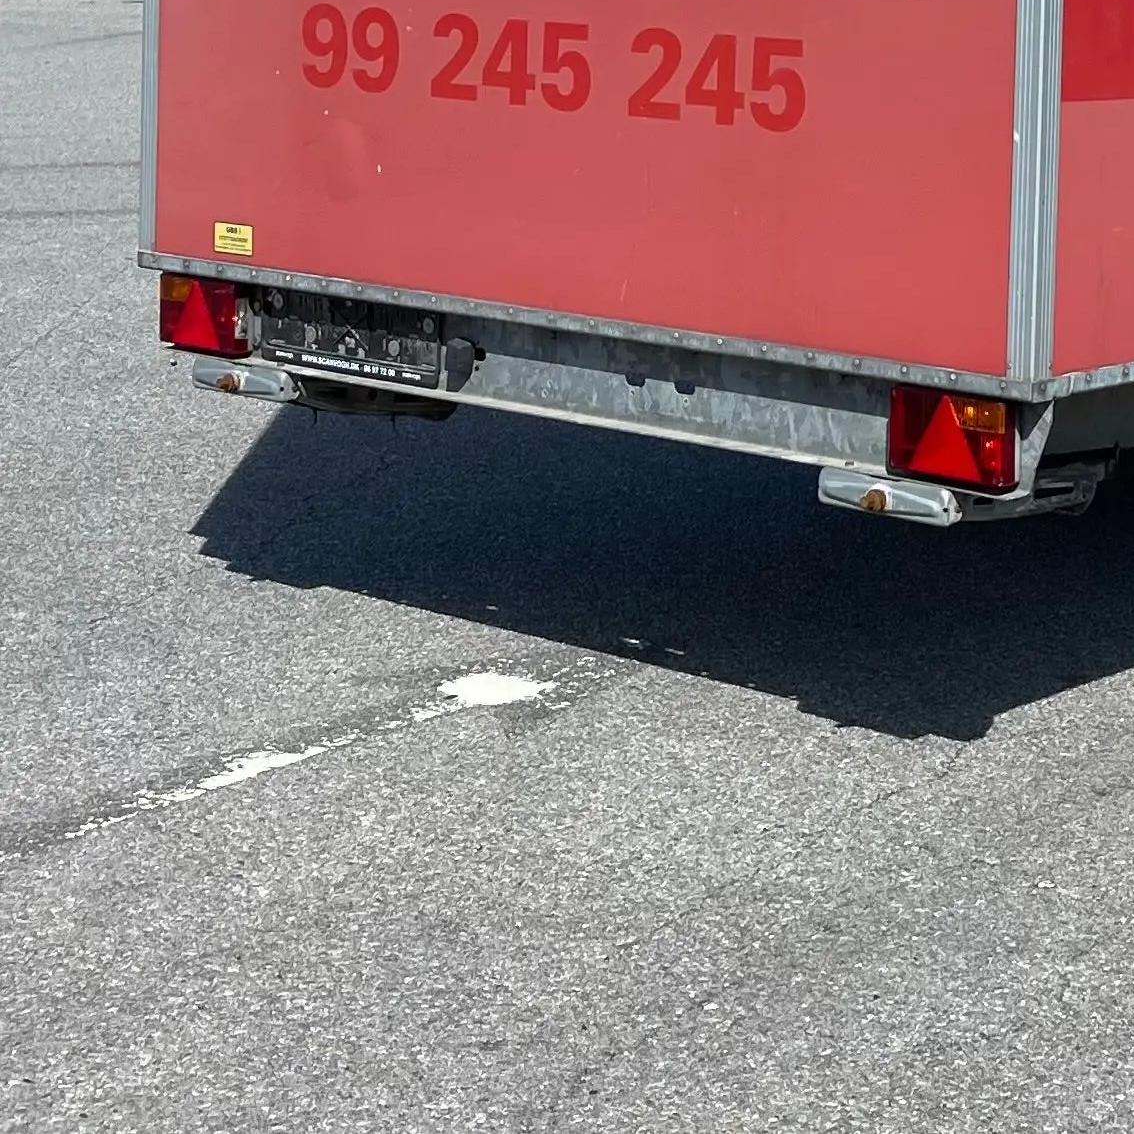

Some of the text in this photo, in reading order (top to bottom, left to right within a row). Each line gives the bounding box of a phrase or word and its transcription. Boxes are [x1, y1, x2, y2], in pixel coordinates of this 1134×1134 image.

[301, 3, 807, 134] 99 245 245
